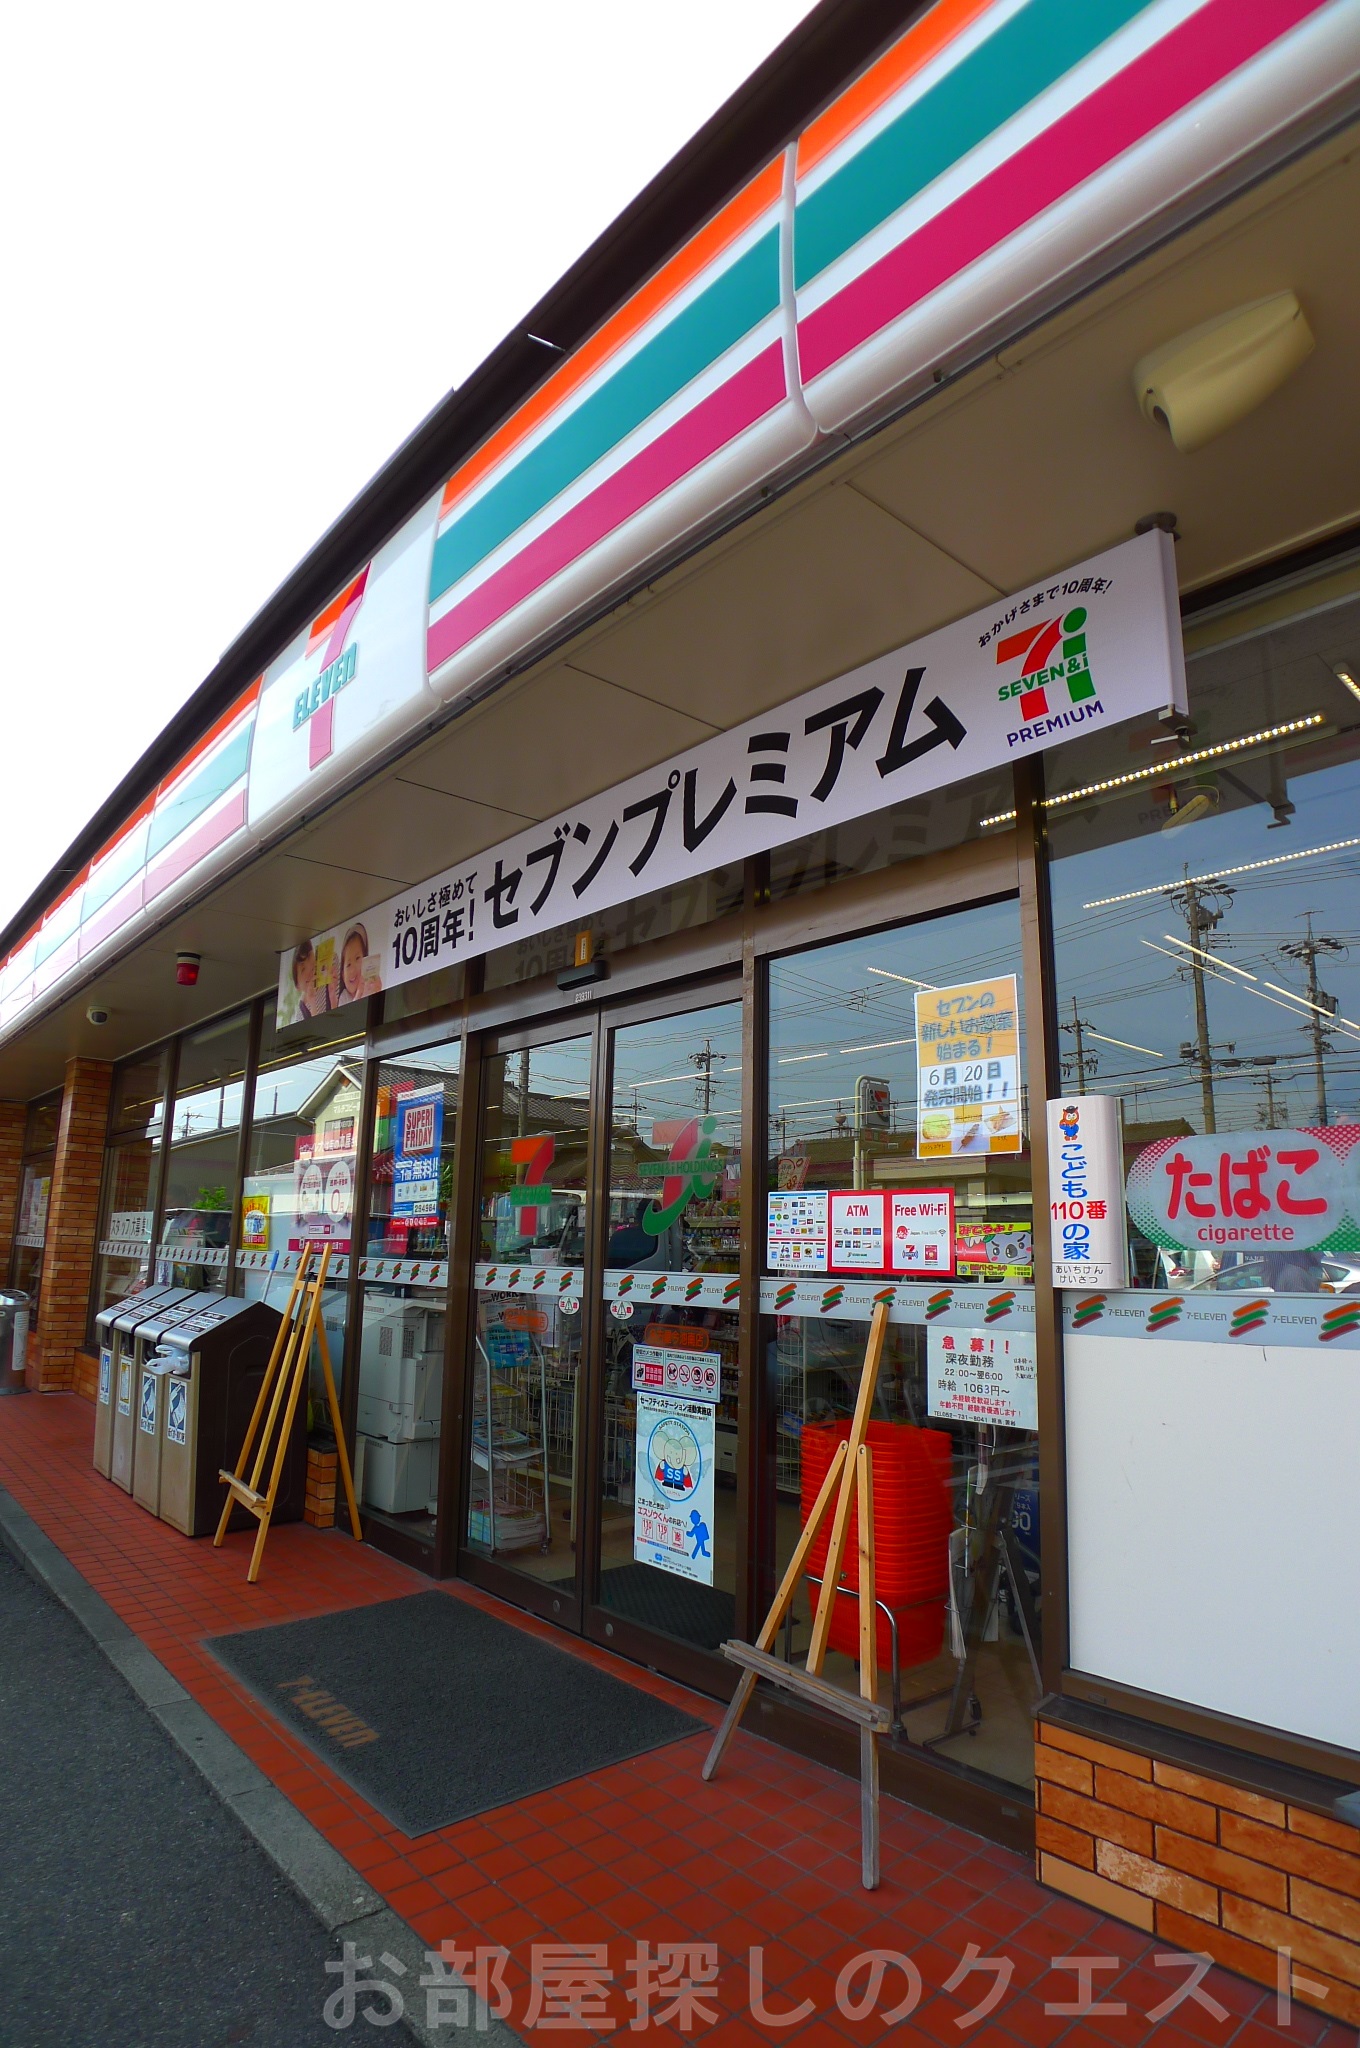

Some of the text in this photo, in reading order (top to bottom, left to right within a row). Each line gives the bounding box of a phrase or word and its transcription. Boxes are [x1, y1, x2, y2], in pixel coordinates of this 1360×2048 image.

[978, 577, 1113, 648] おかげさまで10周年!
[1006, 700, 1105, 747] PREMIUM
[485, 666, 968, 929] セブンプレミアム
[394, 871, 478, 927] おいしさ極めて
[392, 897, 475, 969] 10周年!
[936, 991, 995, 1018] セブンの
[405, 1126, 433, 1149] FRIDAY
[676, 1159, 723, 1174] HOLDINGS
[1165, 1145, 1328, 1220] たばこ
[846, 1204, 869, 1217] ATM
[894, 1203, 947, 1216] Free Wi-Fi
[1198, 1223, 1295, 1243] cigarette
[1055, 1264, 1104, 1275] あいちけん
[1059, 1274, 1099, 1284] けいさつ
[1016, 1304, 1036, 1314] 7-ELE
[1108, 1308, 1145, 1318] 7-ELEVEN
[1186, 1311, 1227, 1322] 7-ELEVEN
[1272, 1314, 1318, 1326] 7-ELEVEN
[945, 1353, 994, 1368] 深夜勤務
[938, 1379, 957, 1392] 時給
[666, 1468, 681, 1481] SS
